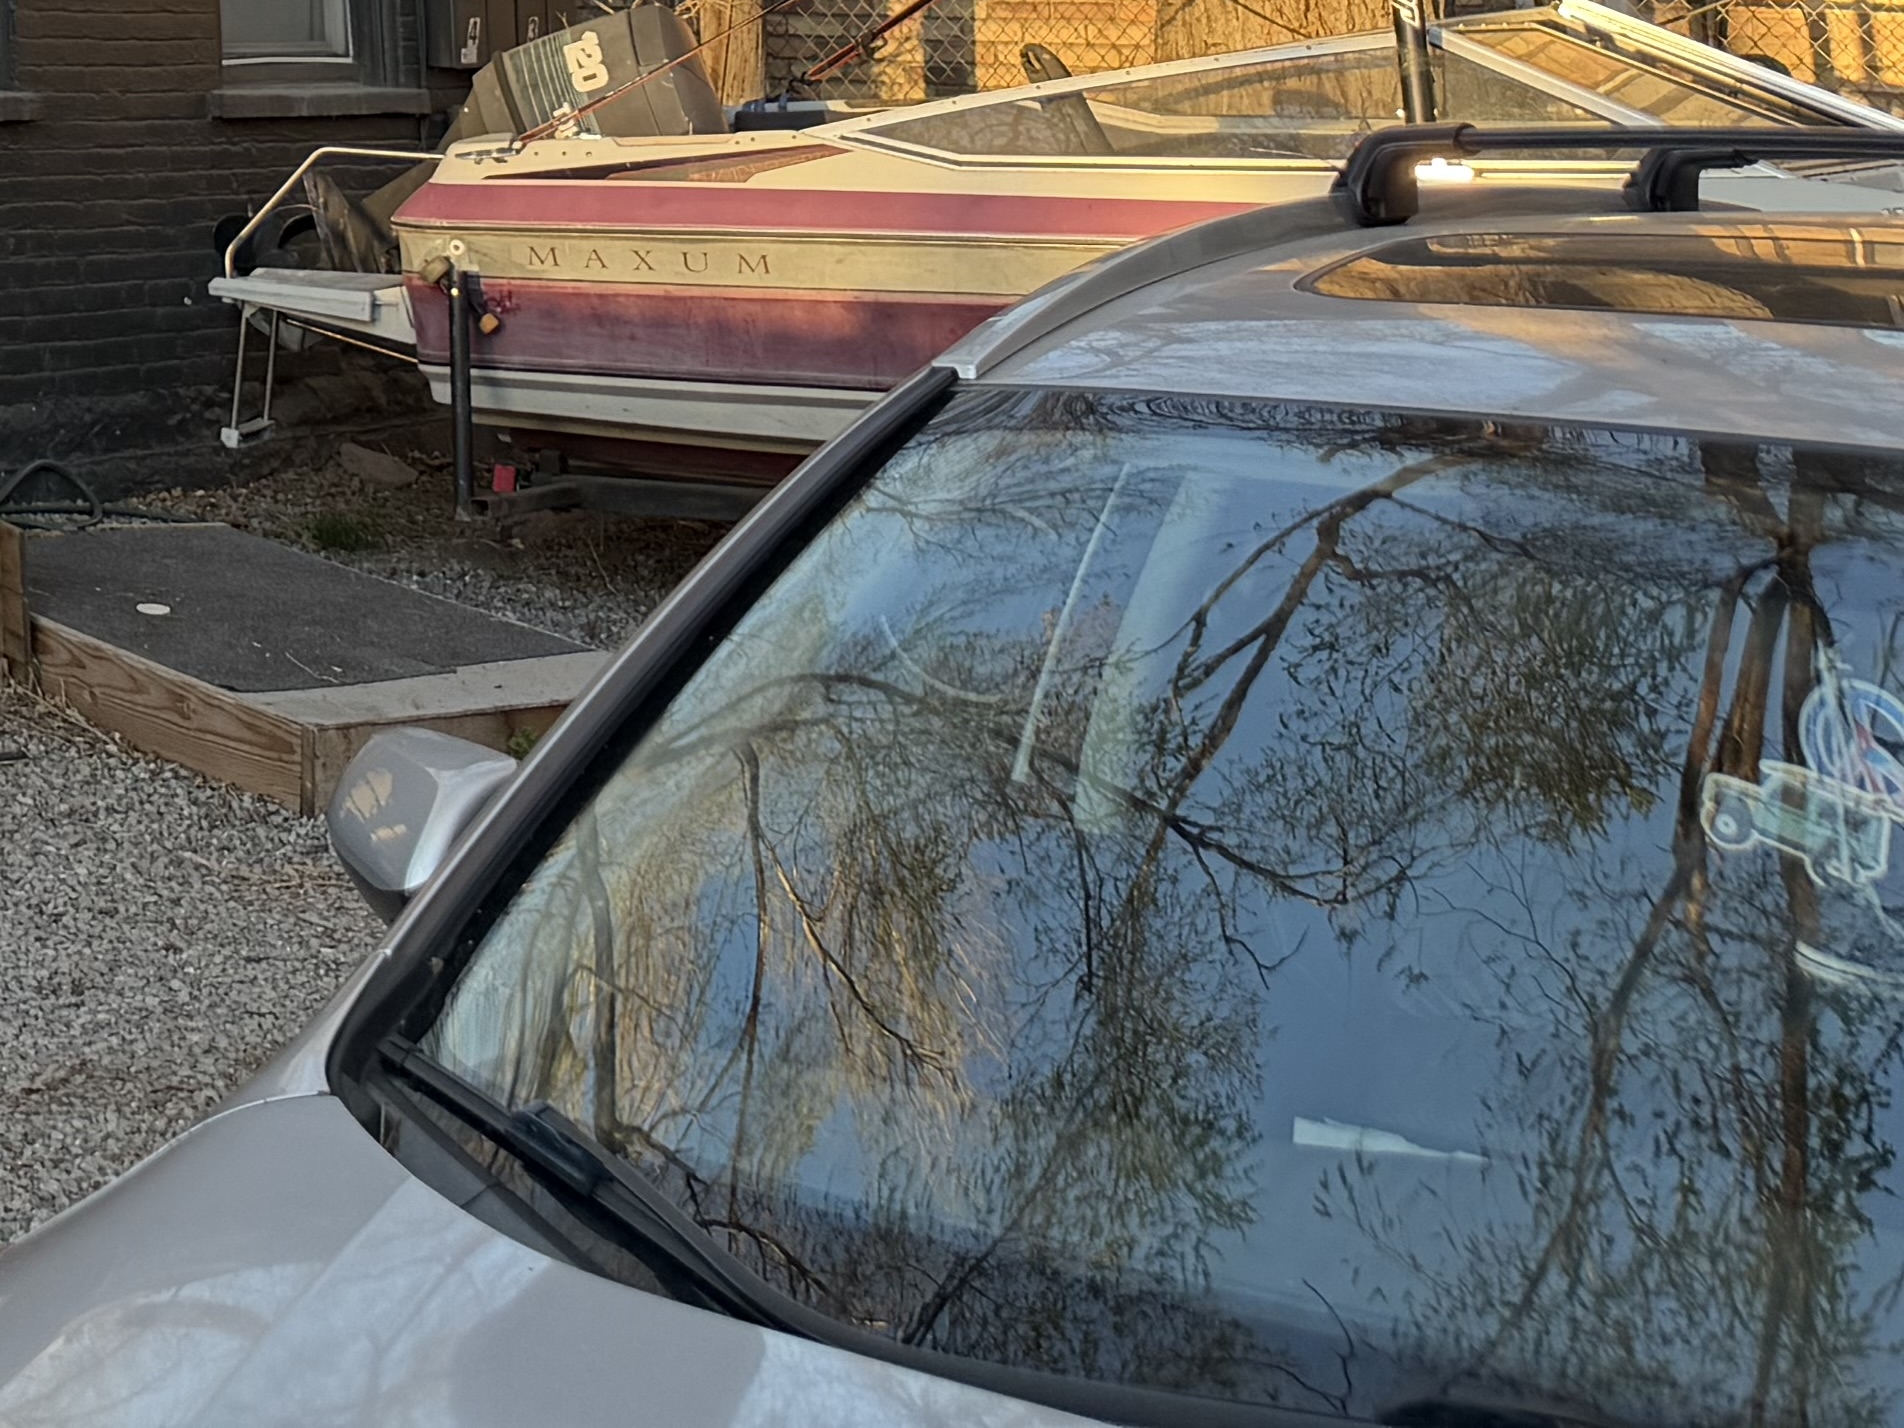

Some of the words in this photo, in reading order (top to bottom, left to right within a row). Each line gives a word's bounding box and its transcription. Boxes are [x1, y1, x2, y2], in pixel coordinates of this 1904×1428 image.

[469, 18, 478, 46] 4
[563, 31, 609, 93] 120
[527, 245, 771, 275] MAXUM
